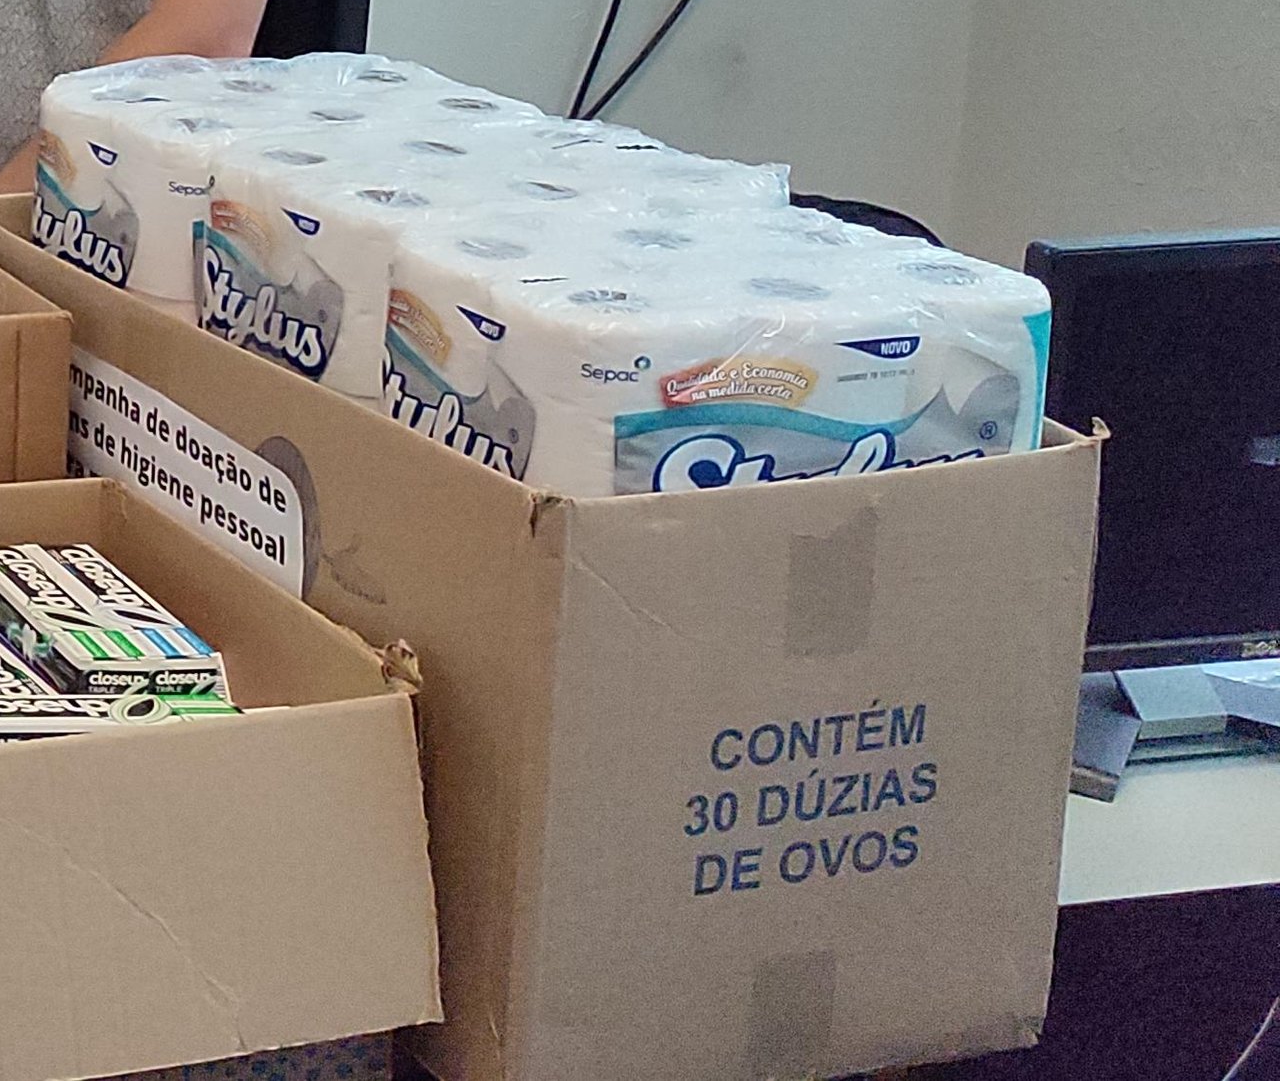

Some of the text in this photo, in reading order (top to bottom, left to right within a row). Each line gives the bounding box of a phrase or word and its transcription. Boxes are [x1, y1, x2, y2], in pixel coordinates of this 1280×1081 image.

[34, 196, 124, 283] tylus
[203, 246, 322, 367] Stylus
[581, 363, 639, 383] Sepac
[730, 368, 739, 379] e
[742, 362, 809, 389] Economia
[881, 341, 911, 355] NOVO
[692, 382, 792, 401] na medida certa
[69, 363, 140, 425] mpanha
[146, 407, 170, 443] de
[176, 425, 252, 492] doação
[259, 476, 286, 513] de
[94, 423, 115, 457] de
[120, 437, 194, 508] higiene
[200, 494, 285, 565] pessoal
[60, 548, 143, 607] closeup
[89, 672, 148, 687] closeup
[156, 671, 209, 686] closeup
[710, 699, 926, 771] CONTÉM
[684, 763, 937, 836] 30 DÚZIAS
[694, 825, 919, 896] DE OVOS
